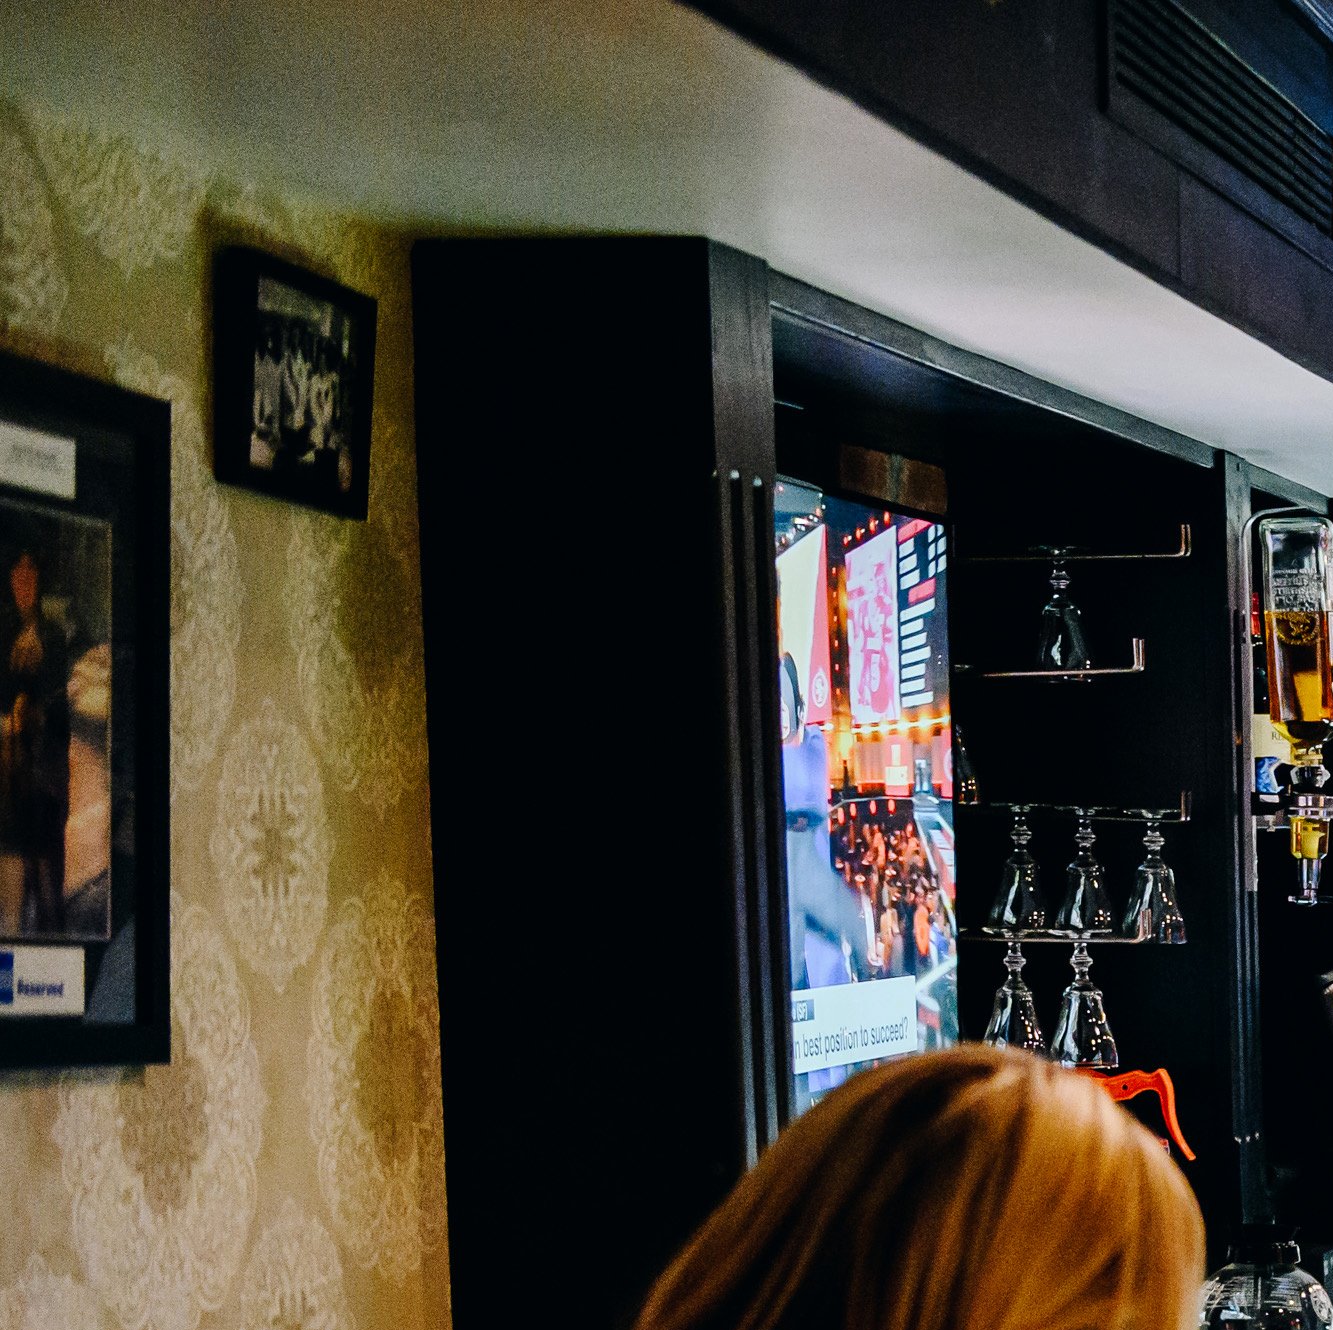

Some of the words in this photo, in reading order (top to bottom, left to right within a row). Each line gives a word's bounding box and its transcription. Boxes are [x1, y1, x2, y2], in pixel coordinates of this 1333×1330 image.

[803, 1033, 823, 1057] best
[824, 1026, 859, 1060] position
[860, 1025, 868, 1046] to
[871, 1016, 909, 1045] succeed?
